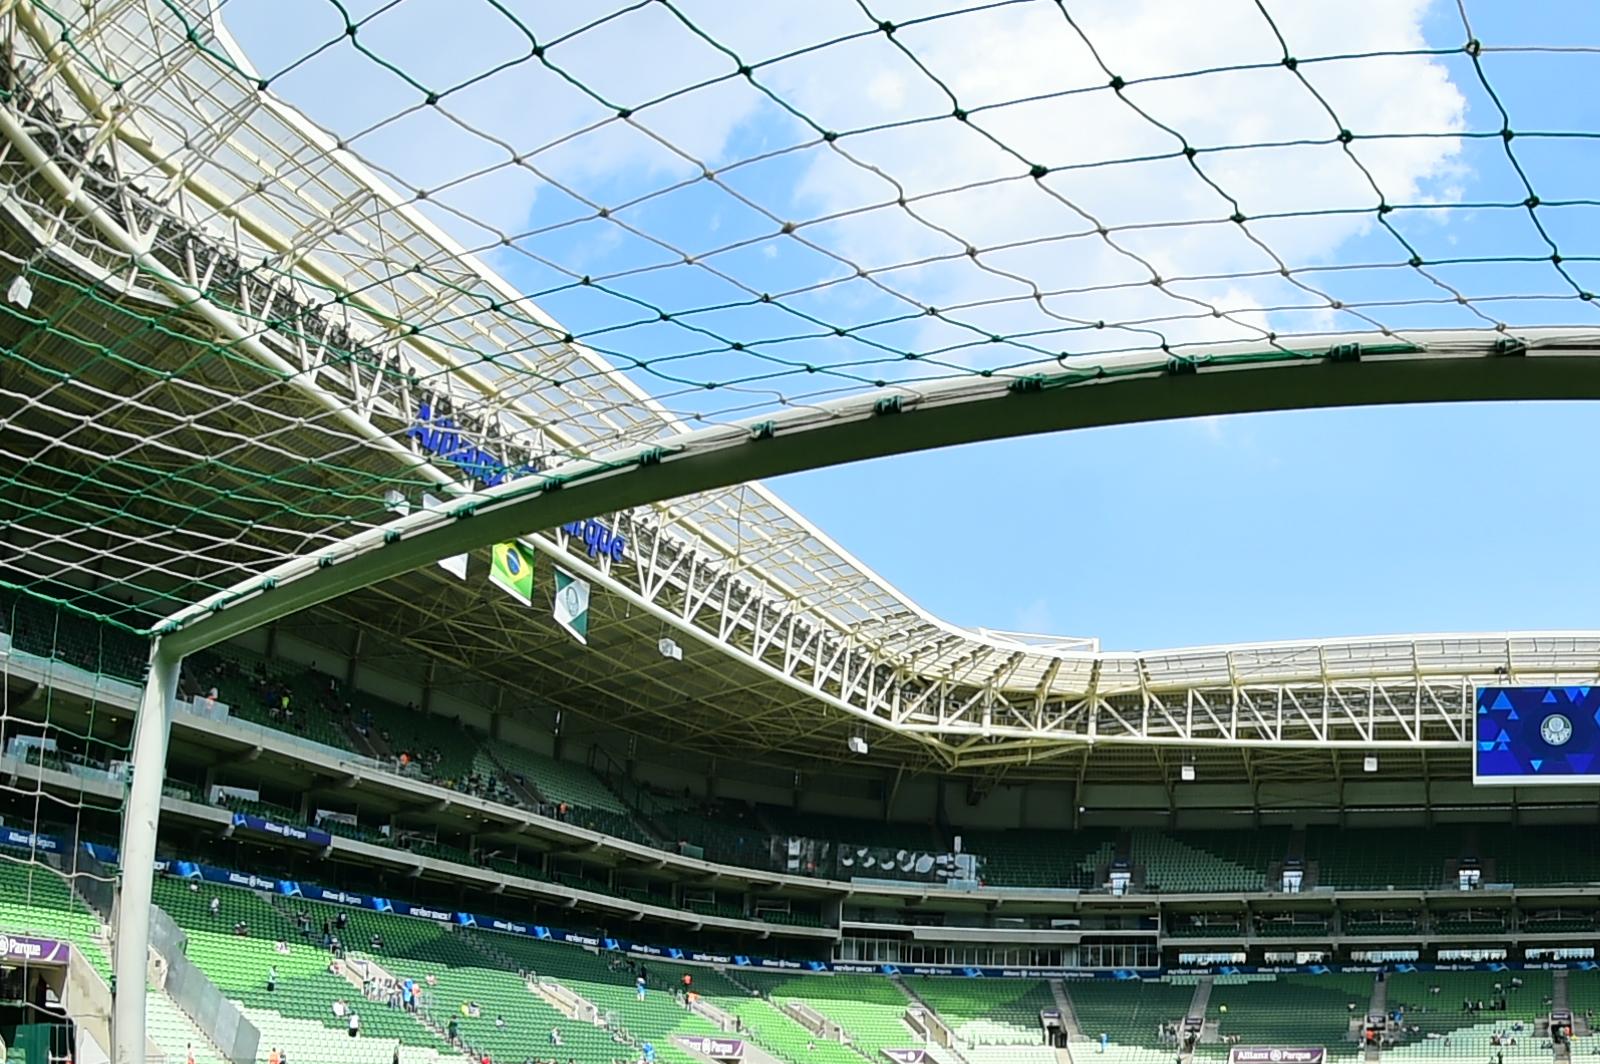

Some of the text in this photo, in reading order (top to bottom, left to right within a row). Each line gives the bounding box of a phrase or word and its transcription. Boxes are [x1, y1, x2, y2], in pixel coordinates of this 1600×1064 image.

[9, 936, 41, 958] Parque
[1237, 1050, 1312, 1062] Allianz Parque
